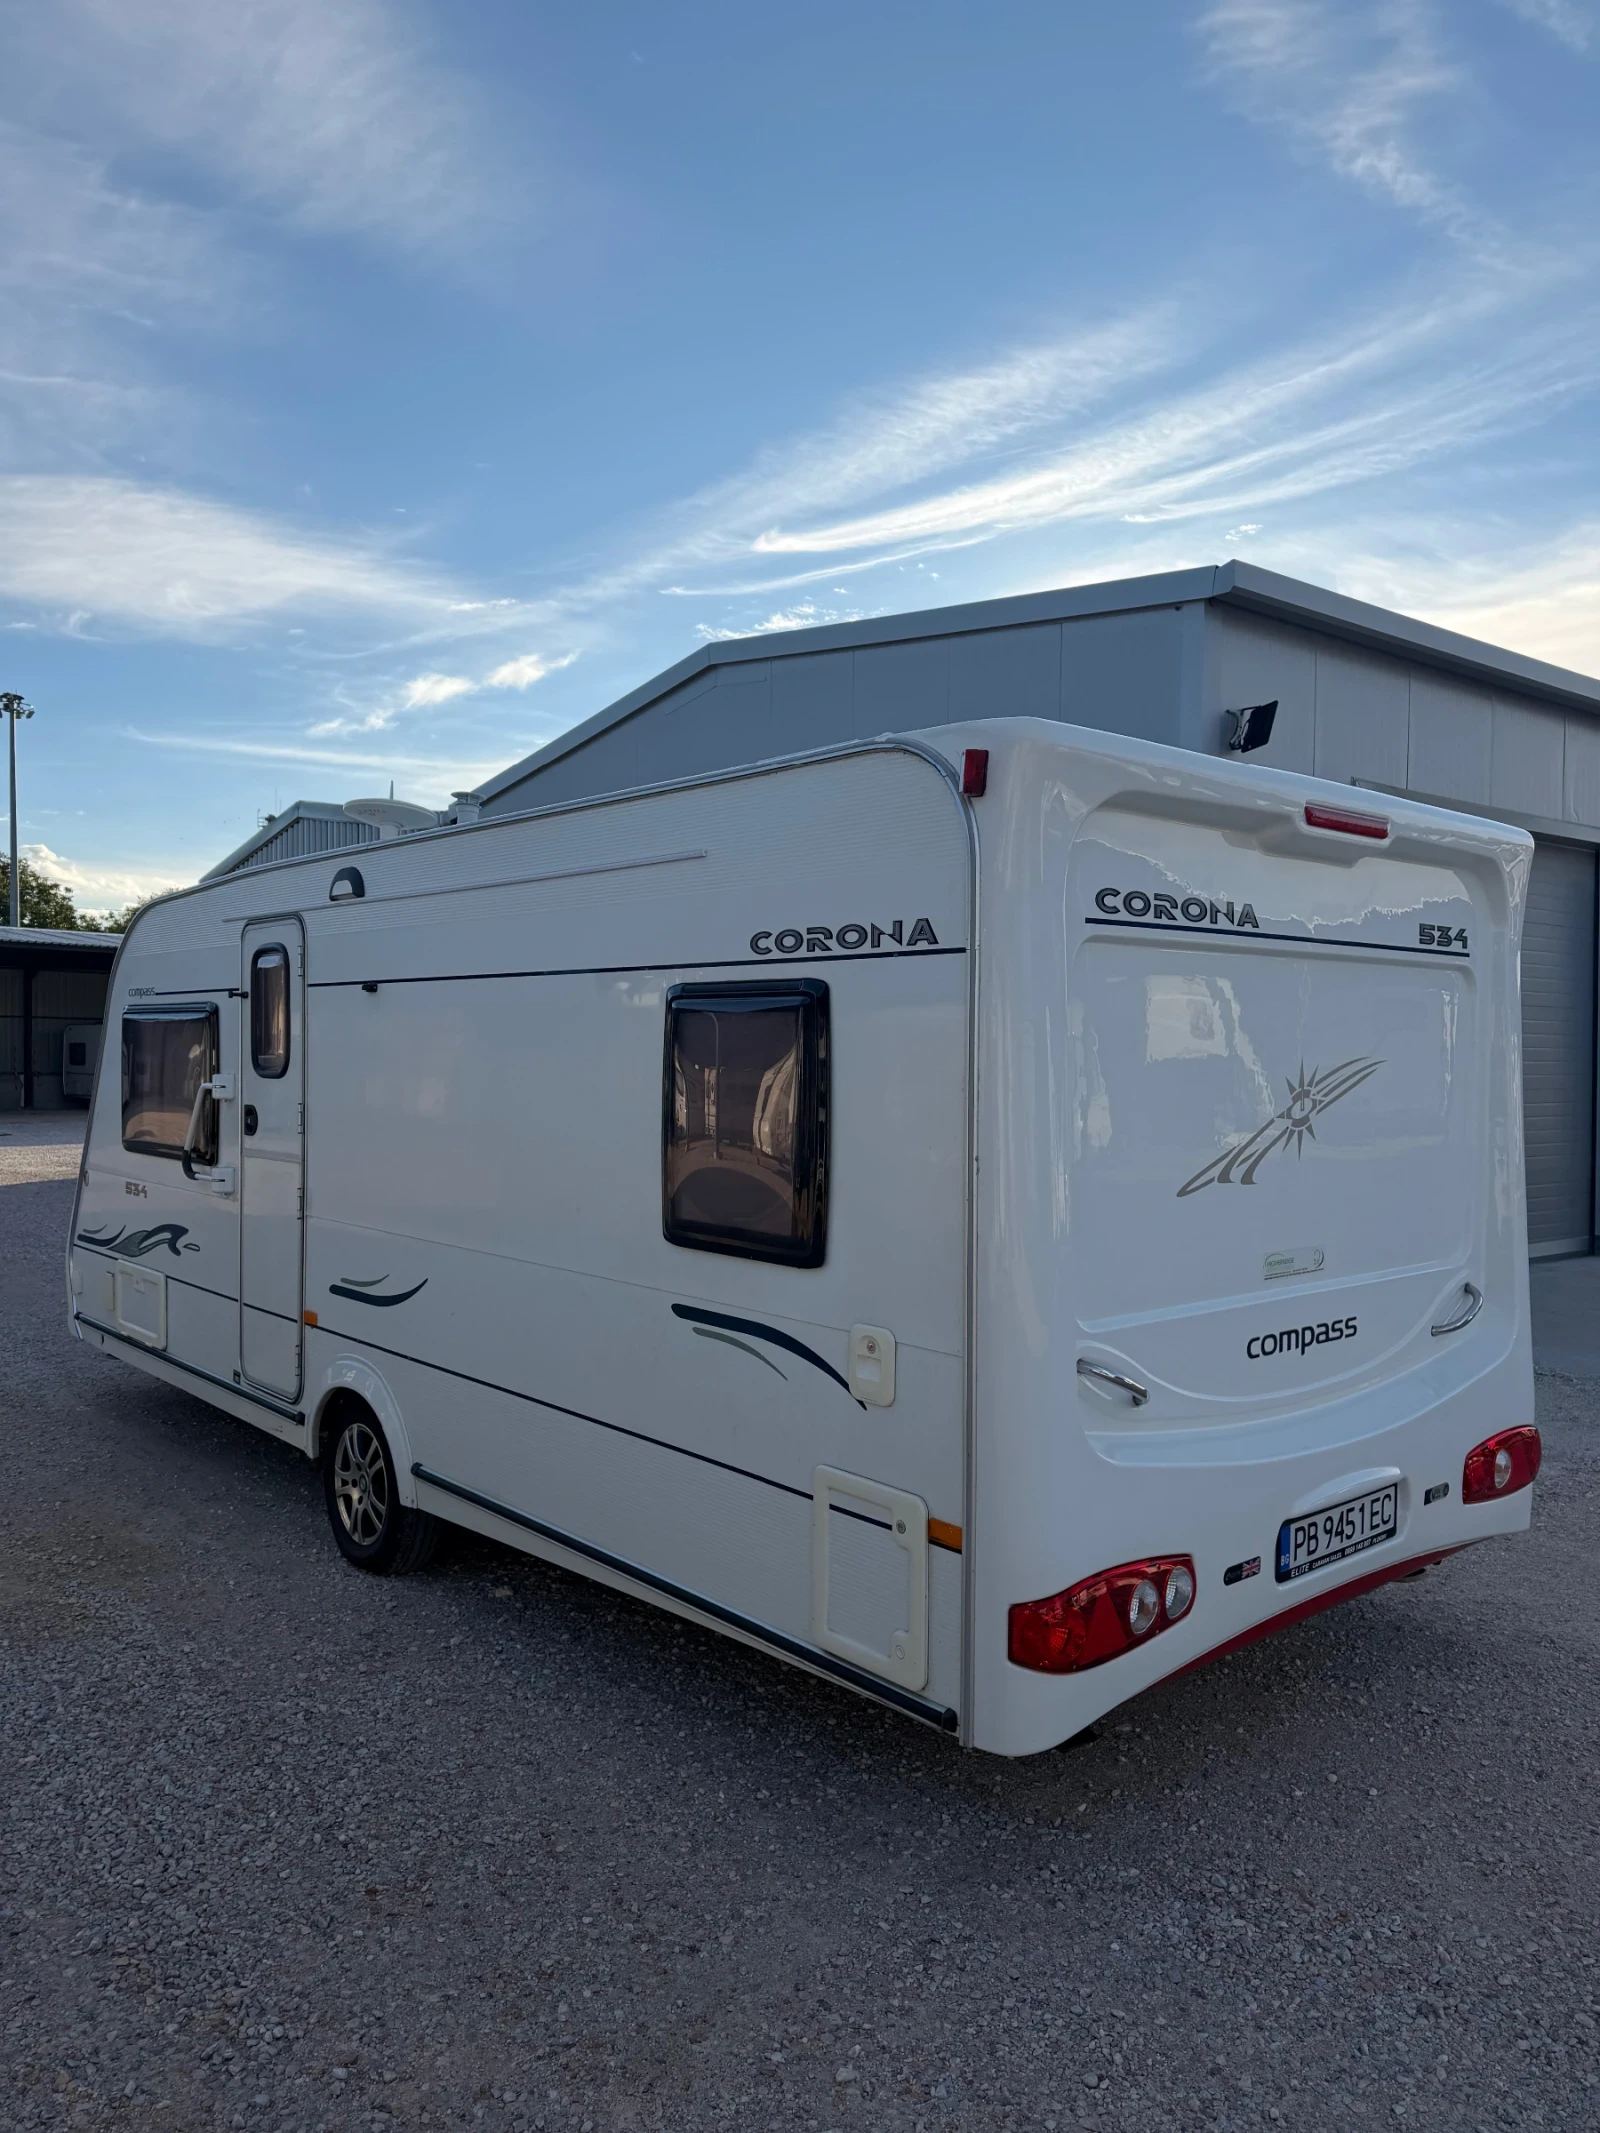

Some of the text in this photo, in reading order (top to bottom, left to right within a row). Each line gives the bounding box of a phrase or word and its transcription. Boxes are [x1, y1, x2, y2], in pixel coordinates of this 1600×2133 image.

[1095, 887, 1468, 949] CORONA 534
[750, 917, 939, 955] CORONA
[128, 987, 155, 999] compass
[125, 1181, 148, 1198] 534
[1246, 1316, 1358, 1359] compass
[1294, 1493, 1392, 1561] PB 9451 EC
[1281, 1554, 1290, 1566] BG
[1291, 1563, 1310, 1577] ELITE
